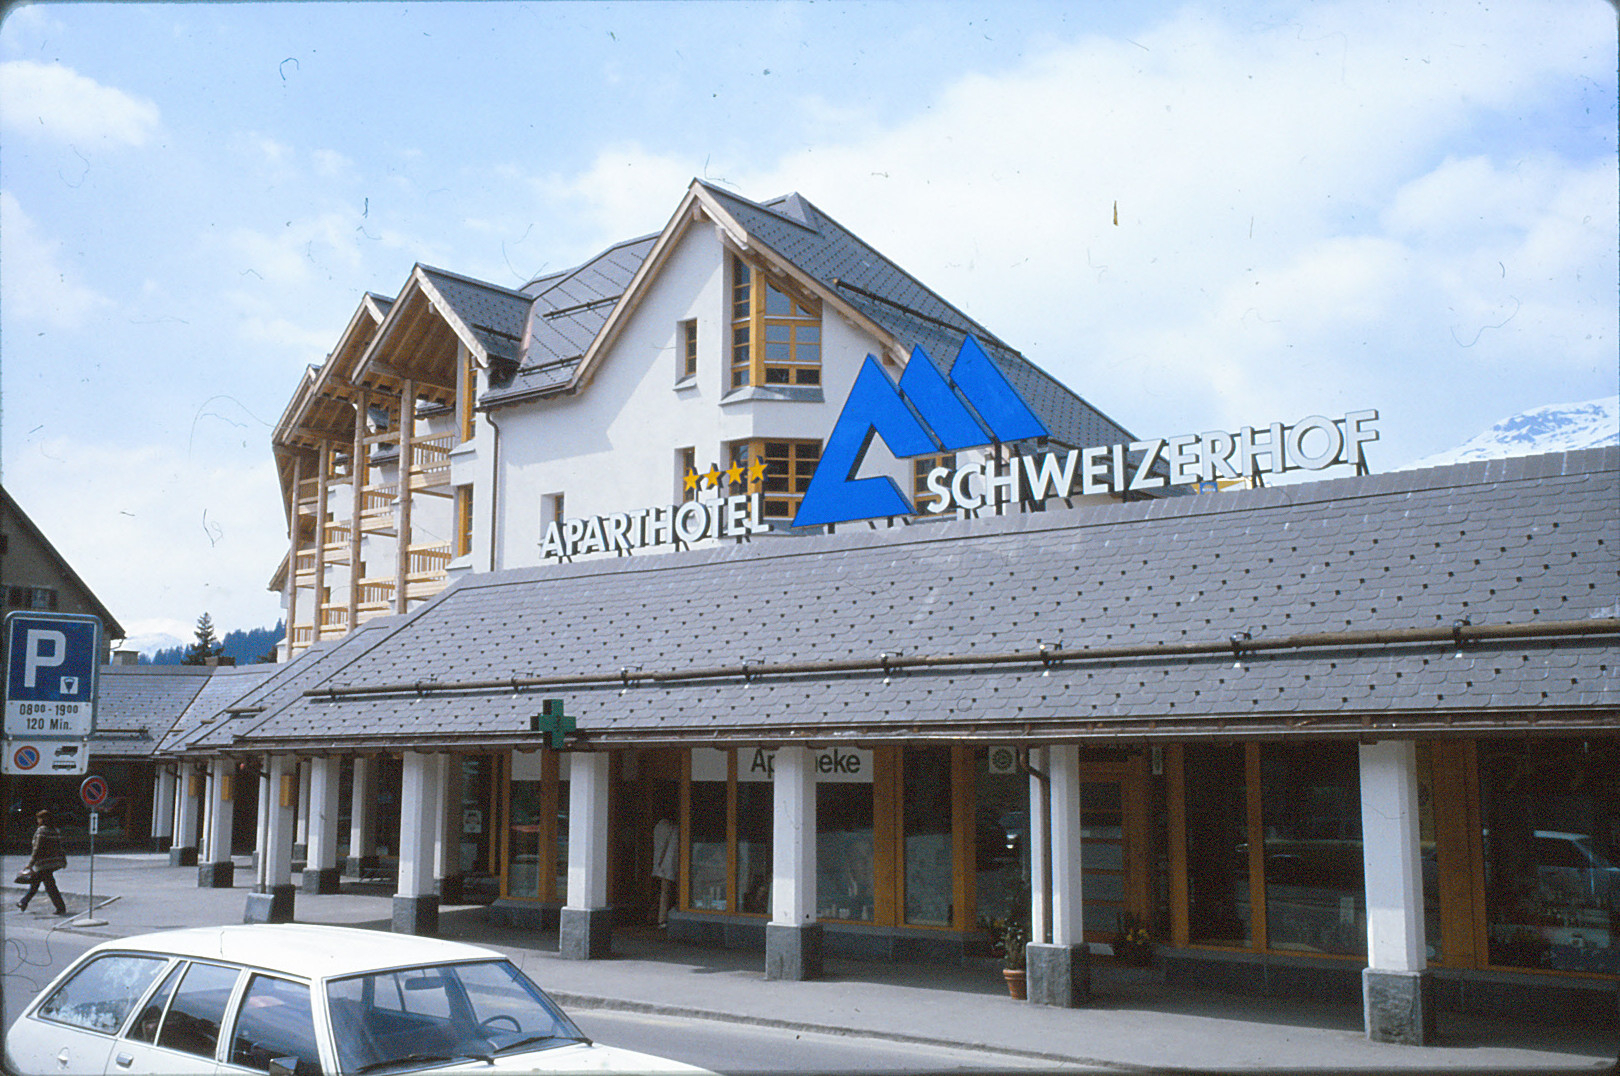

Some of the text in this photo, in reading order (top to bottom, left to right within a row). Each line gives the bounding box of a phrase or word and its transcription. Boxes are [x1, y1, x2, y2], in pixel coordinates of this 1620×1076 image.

[540, 409, 1379, 558] APARTHOTEL SCHWEIZERHOF
[24, 629, 66, 687] P
[27, 718, 72, 730] 120 Min.
[751, 749, 860, 779] Apeke
